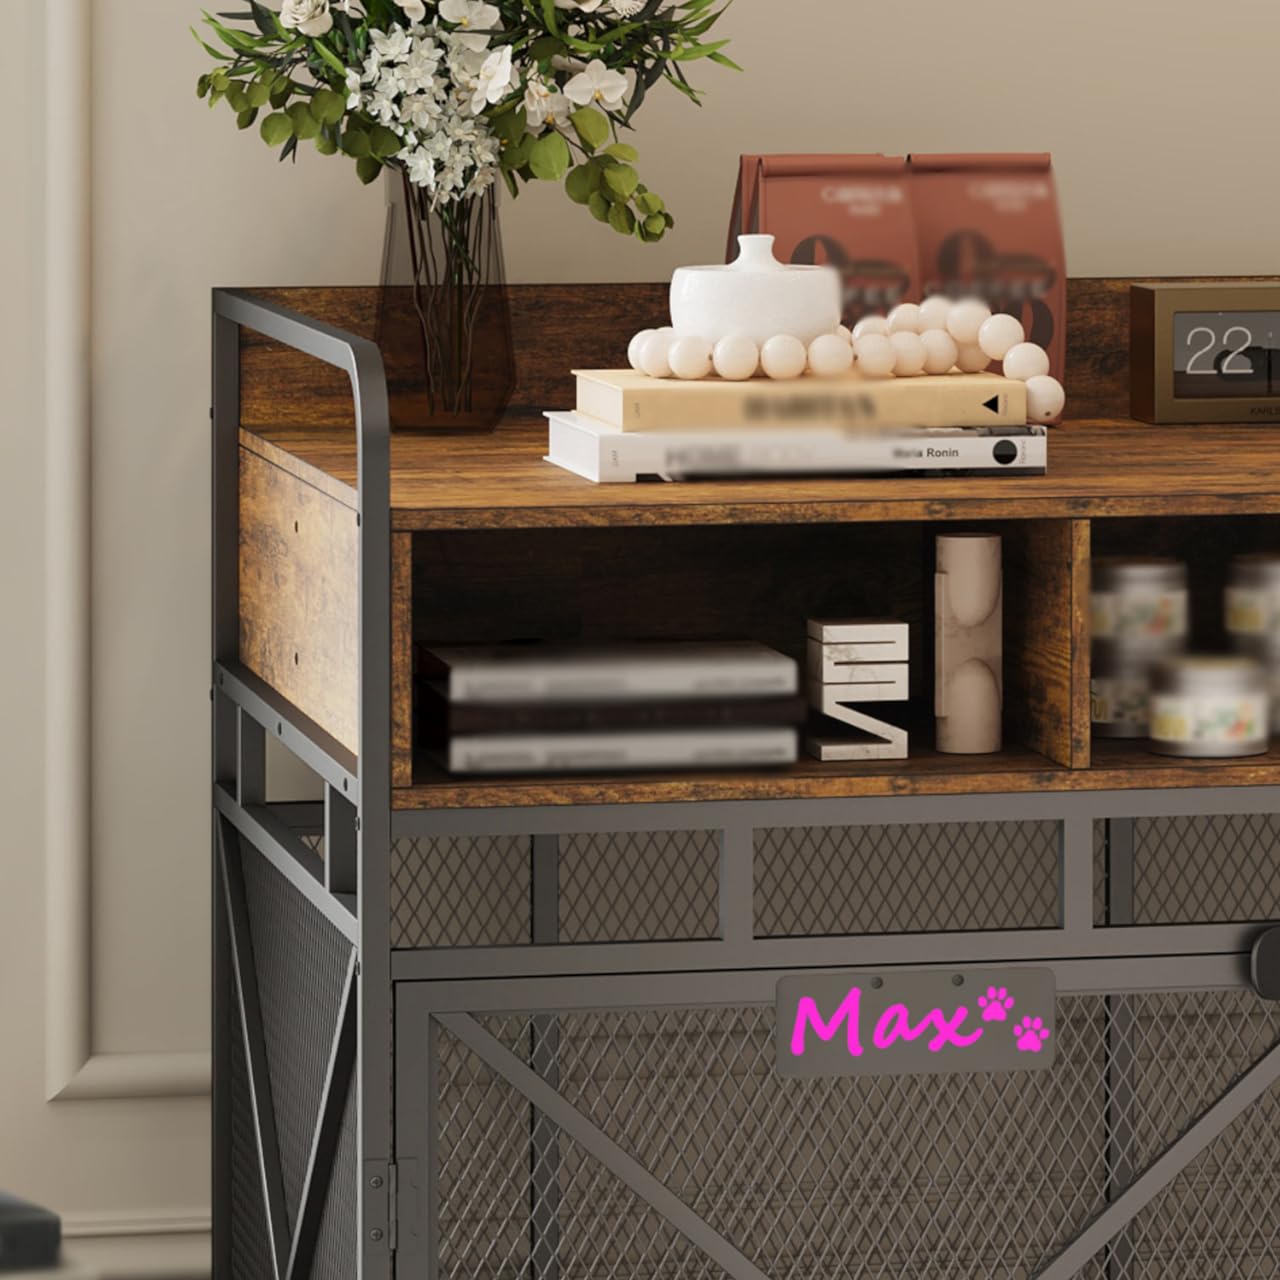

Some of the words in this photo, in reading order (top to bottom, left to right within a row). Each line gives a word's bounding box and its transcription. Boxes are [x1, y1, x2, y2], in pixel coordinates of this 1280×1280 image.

[1186, 326, 1254, 375] 22
[926, 447, 959, 458] Ronin
[791, 986, 984, 1056] Max
